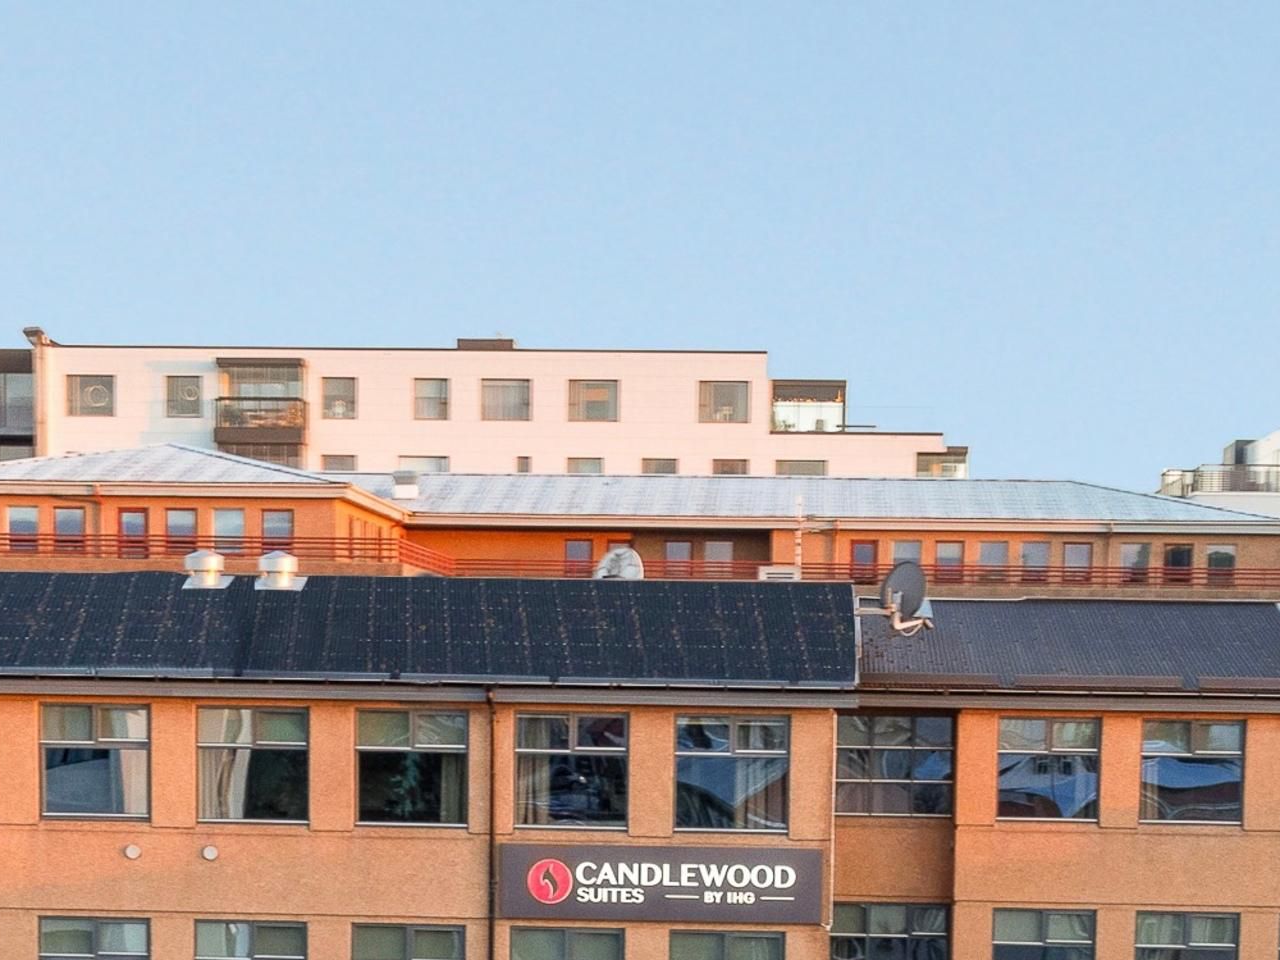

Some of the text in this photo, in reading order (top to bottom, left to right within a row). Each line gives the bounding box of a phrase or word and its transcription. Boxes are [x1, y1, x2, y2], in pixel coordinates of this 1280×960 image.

[575, 861, 797, 890] CANDLEWOOD
[576, 887, 756, 905] SUITES BY IHG
